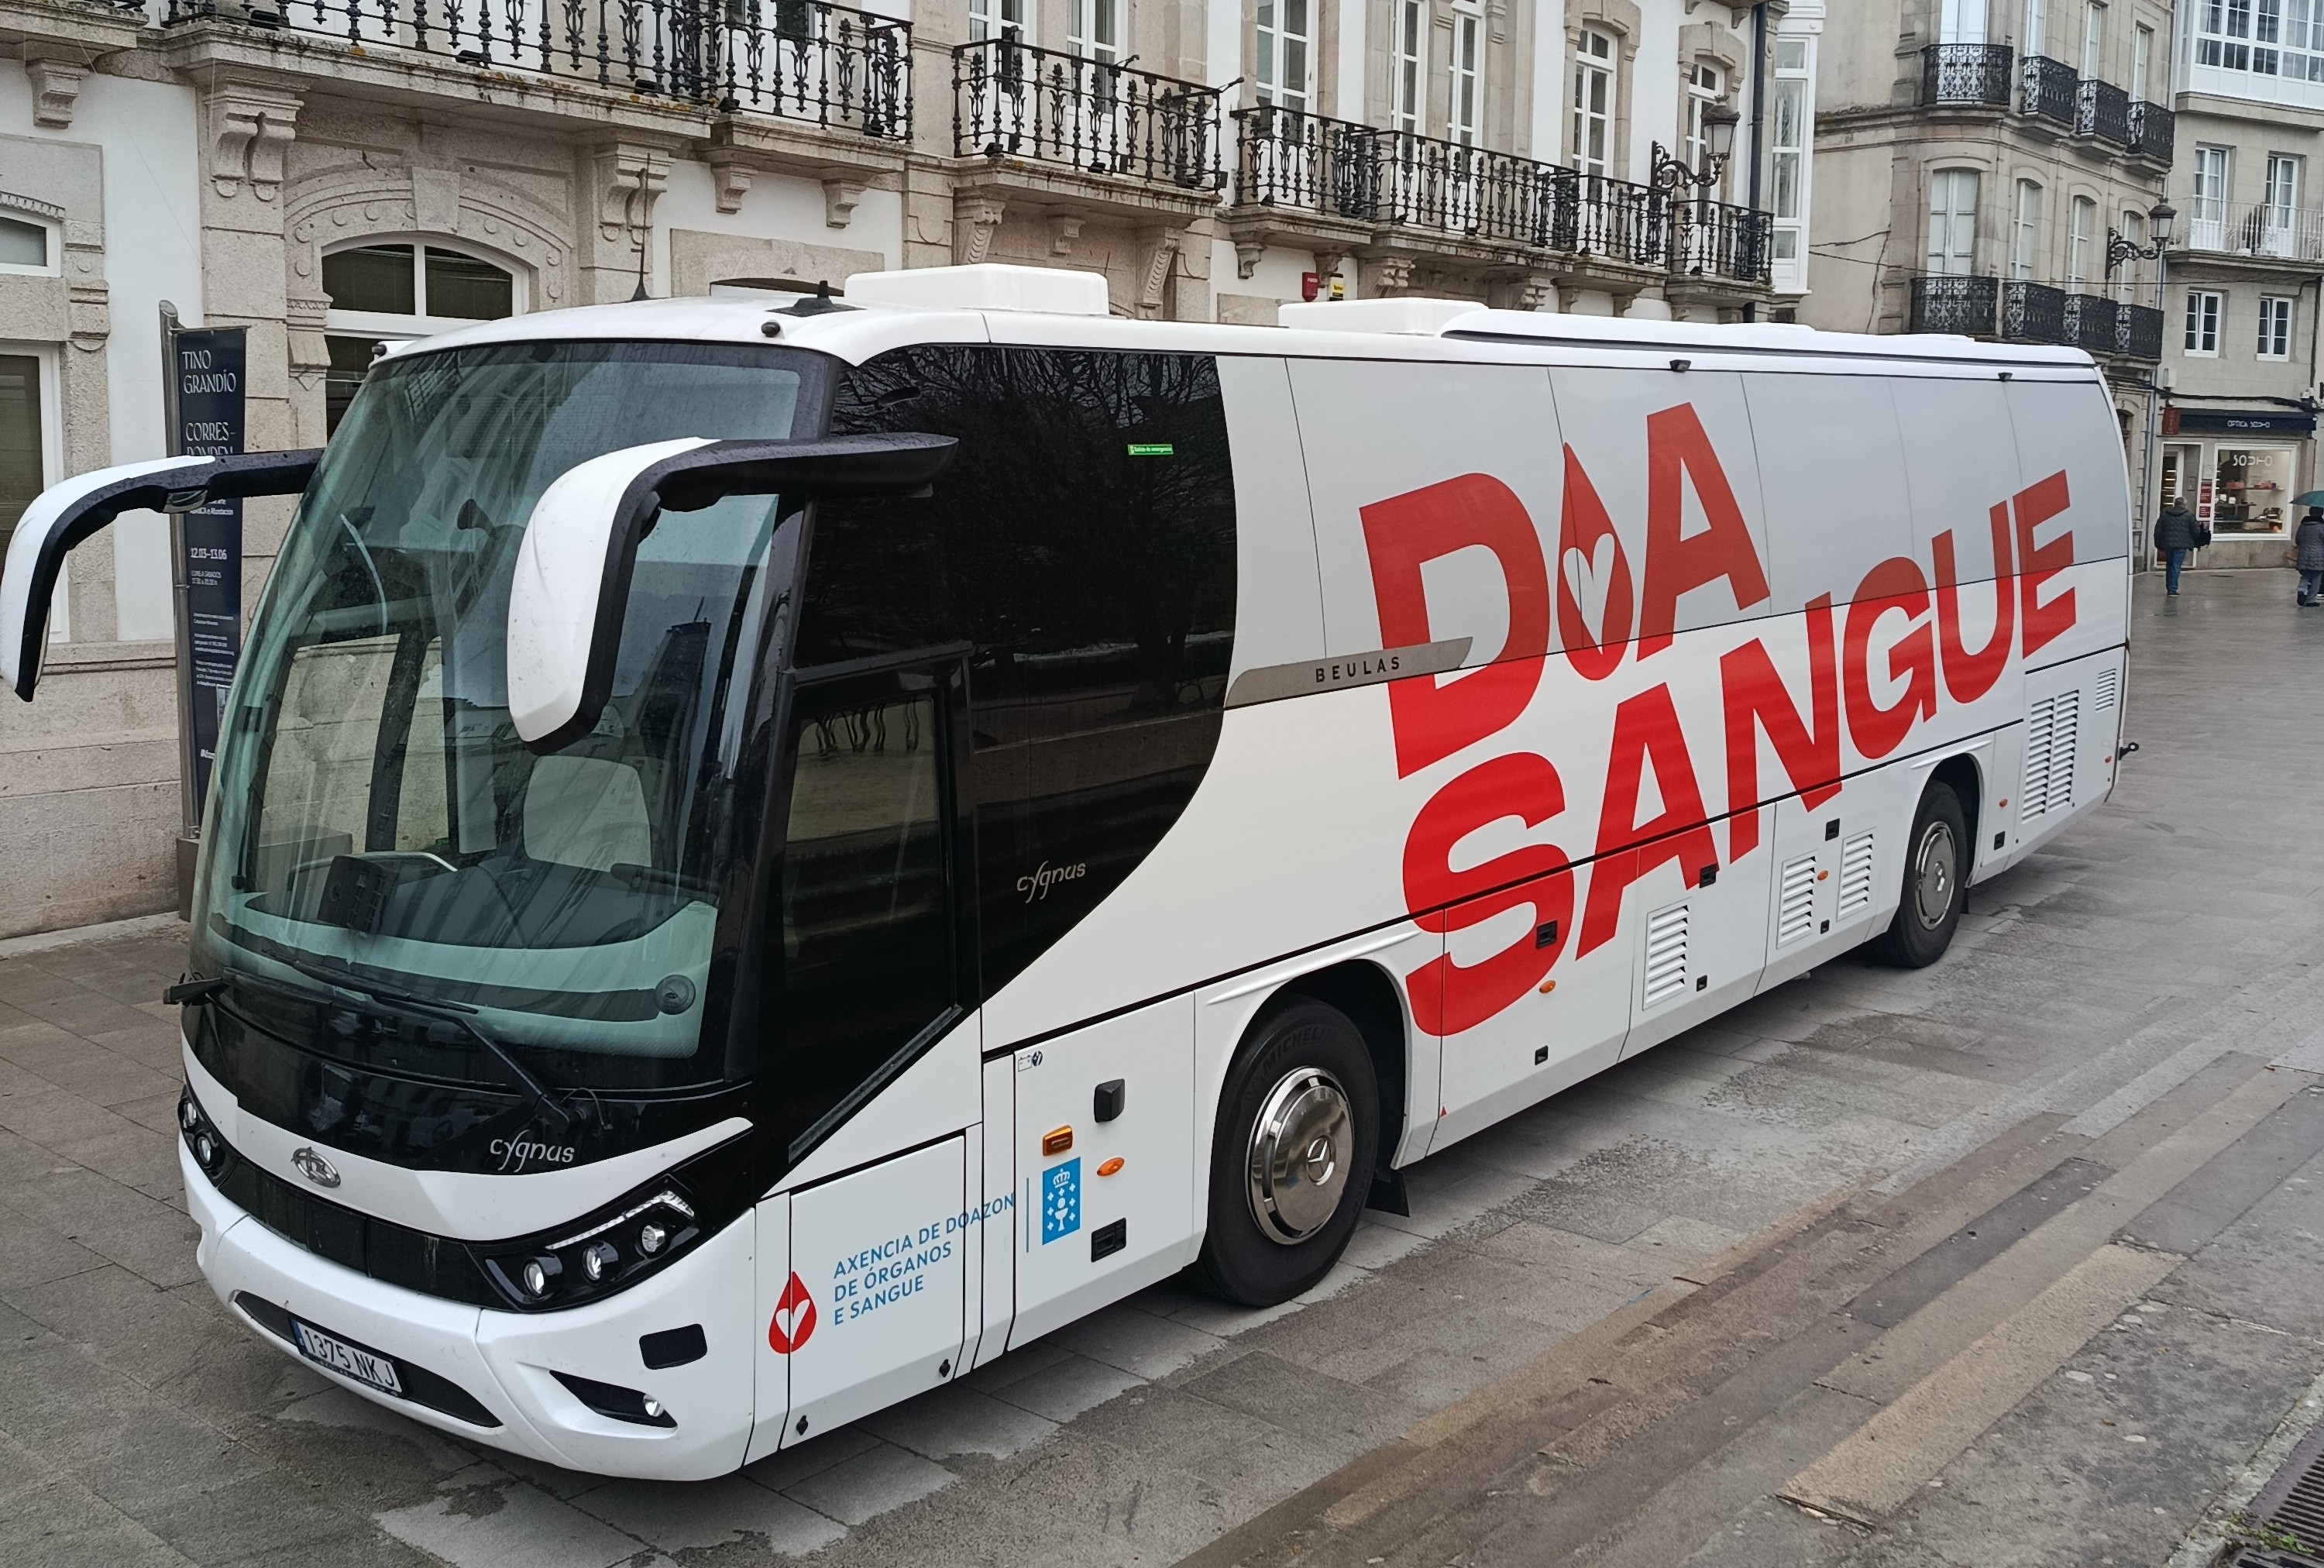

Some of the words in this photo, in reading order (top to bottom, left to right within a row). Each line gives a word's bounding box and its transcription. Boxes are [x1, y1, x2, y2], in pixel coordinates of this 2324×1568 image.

[182, 349, 211, 370] TINO
[183, 369, 236, 394] GRANDÍO
[185, 421, 236, 442] CORRES-
[1315, 656, 1401, 683] BEULAS
[1402, 469, 2077, 1037] SANGUE
[1016, 860, 1086, 904] cygnus
[1261, 1026, 1334, 1075] MICHELIN
[490, 1129, 575, 1173] cygnus
[834, 1234, 913, 1280] AXENCIA
[919, 1222, 940, 1245] DE
[834, 1280, 858, 1303] DE
[863, 1241, 952, 1290] ÓRGANOS
[834, 1307, 845, 1326] E
[850, 1274, 924, 1319] SANGUE
[304, 1329, 352, 1370] 1375
[352, 1350, 395, 1387] NKJ
